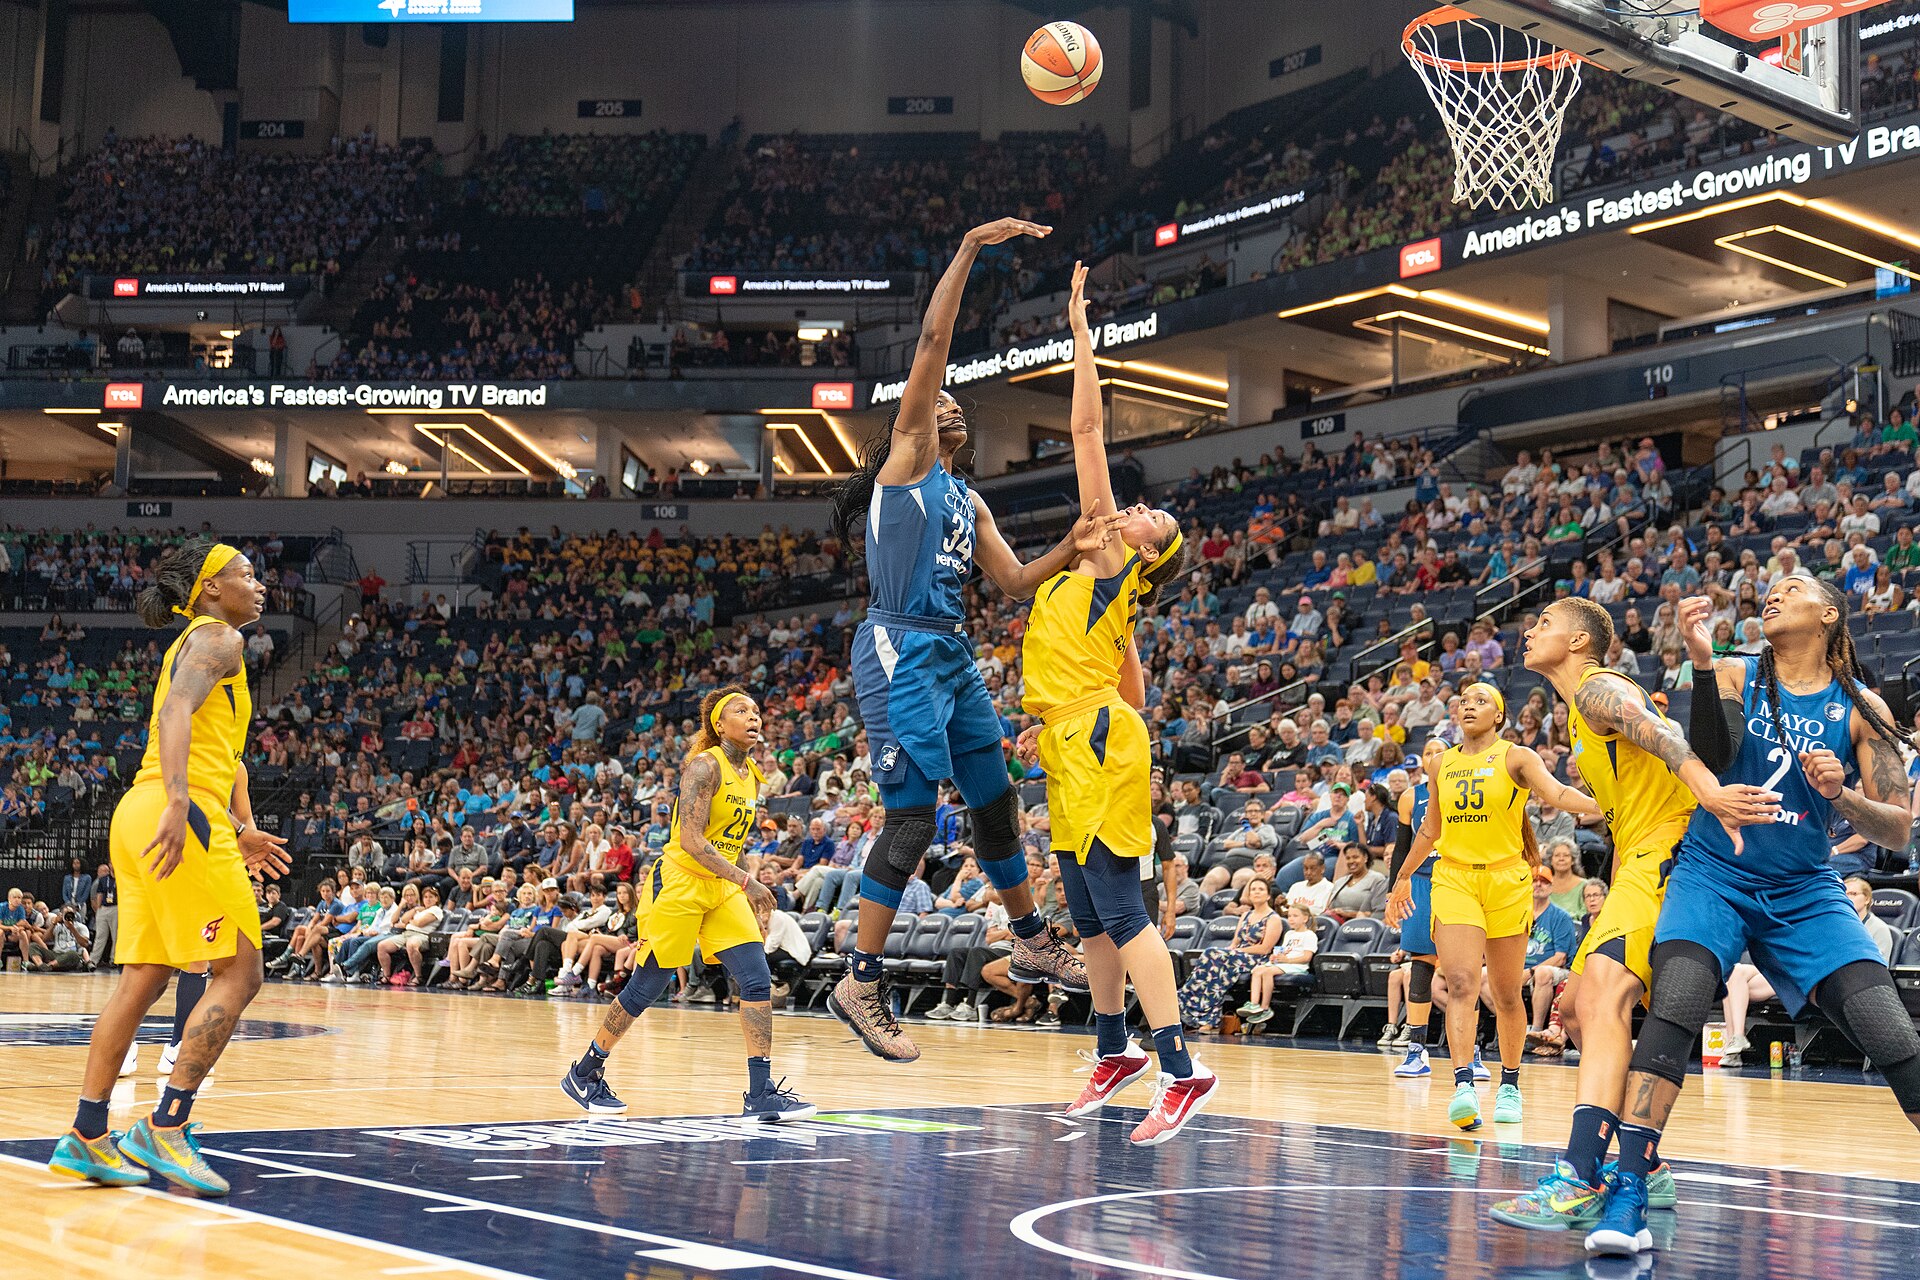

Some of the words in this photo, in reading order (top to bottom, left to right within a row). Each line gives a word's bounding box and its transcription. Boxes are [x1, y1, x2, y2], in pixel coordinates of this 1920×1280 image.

[257, 122, 286, 137] 204
[1462, 206, 1582, 259] America's
[1586, 150, 1811, 228] Fastest-Growing
[1817, 134, 1860, 170] TV
[1867, 123, 1920, 159] Bra
[1405, 249, 1435, 267] TCL
[145, 282, 183, 293] America's
[184, 282, 248, 294] Fastest-Growing
[248, 282, 260, 292] TV
[260, 282, 286, 292] Brand
[742, 280, 783, 291] America's
[945, 337, 1074, 387] Fastest-Growing
[1103, 312, 1157, 347] Brand
[1643, 365, 1673, 384] 110
[110, 389, 137, 402] TCL
[162, 384, 265, 406] America's
[270, 384, 443, 409] Fastest-Growing
[447, 384, 478, 405] TV
[482, 384, 547, 406] Brand
[817, 390, 847, 401] TCL
[1311, 417, 1335, 435] 109
[139, 503, 160, 516] 104
[653, 506, 677, 518] 106
[943, 512, 974, 562] 34
[1445, 769, 1473, 780] FINISH
[1753, 747, 1793, 802] 2
[1454, 779, 1485, 811] 35
[722, 807, 753, 841] 25
[1447, 812, 1488, 824] verizon
